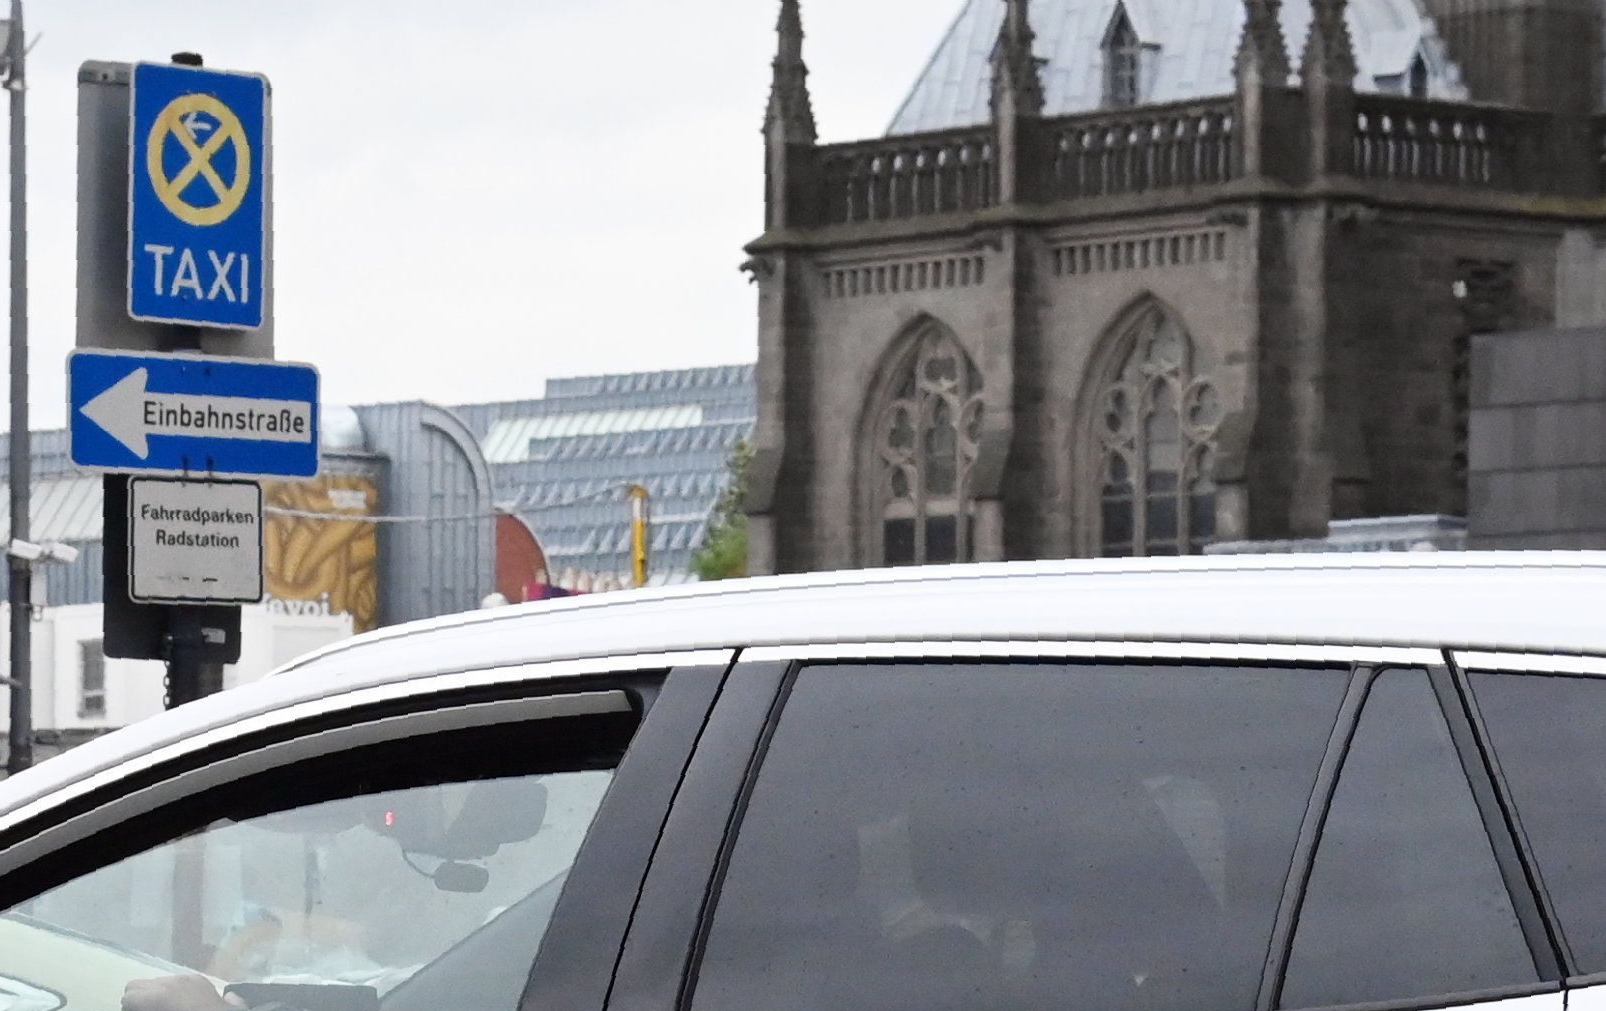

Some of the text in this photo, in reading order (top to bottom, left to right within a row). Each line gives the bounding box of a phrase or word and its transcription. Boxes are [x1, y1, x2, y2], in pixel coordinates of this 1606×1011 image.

[144, 243, 249, 304] TAXI
[144, 401, 305, 433] Einbahnstraße
[141, 504, 255, 526] Fahrradparken
[155, 529, 240, 548] Radstation
